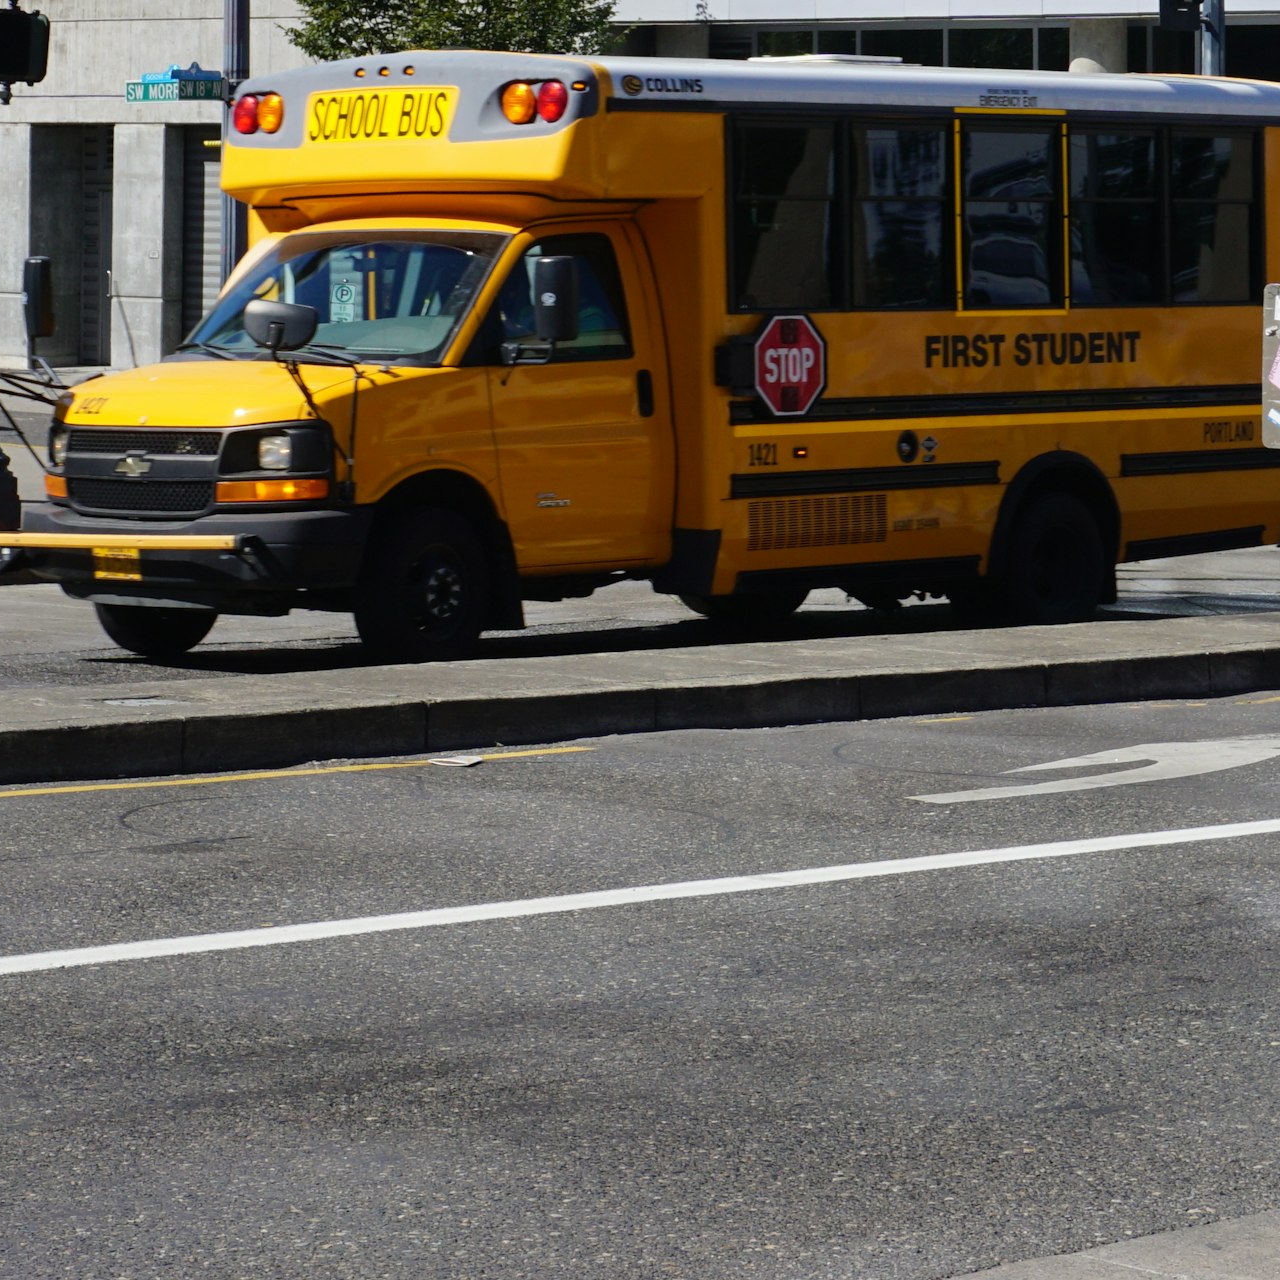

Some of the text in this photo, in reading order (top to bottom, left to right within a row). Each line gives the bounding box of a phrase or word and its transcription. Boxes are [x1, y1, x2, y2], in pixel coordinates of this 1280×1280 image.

[127, 84, 144, 100] SW
[181, 81, 194, 97] SW
[645, 78, 703, 93] COLLINS
[979, 95, 1038, 107] EMERGENCY EXIT
[309, 92, 447, 141] SCHOOL BUS
[924, 331, 1141, 368] FIRST STUDENT
[764, 347, 815, 383] STOP
[1203, 421, 1254, 443] PORTLAND
[748, 443, 778, 467] 1421
